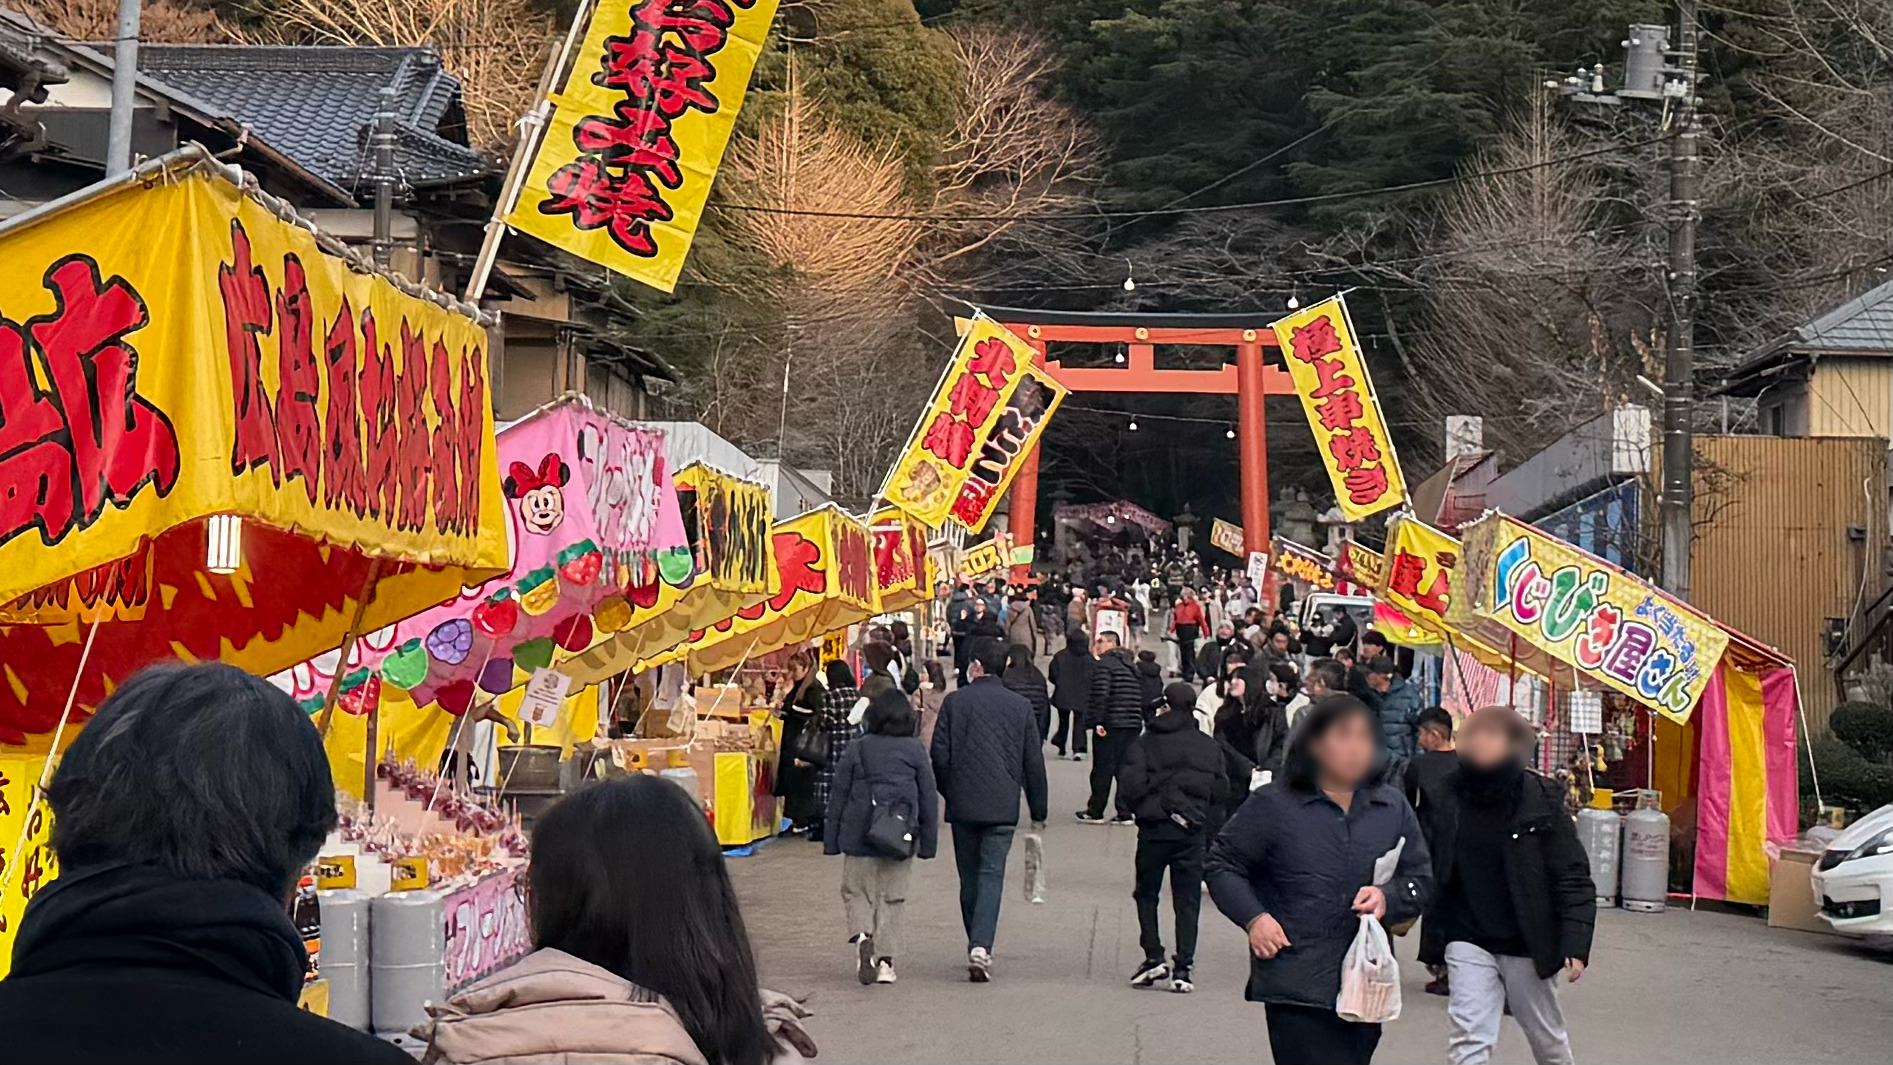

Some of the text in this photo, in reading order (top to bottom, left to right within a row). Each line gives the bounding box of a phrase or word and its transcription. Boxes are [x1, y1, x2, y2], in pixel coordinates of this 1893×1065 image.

[1493, 535, 1692, 713] くじびき屋さん
